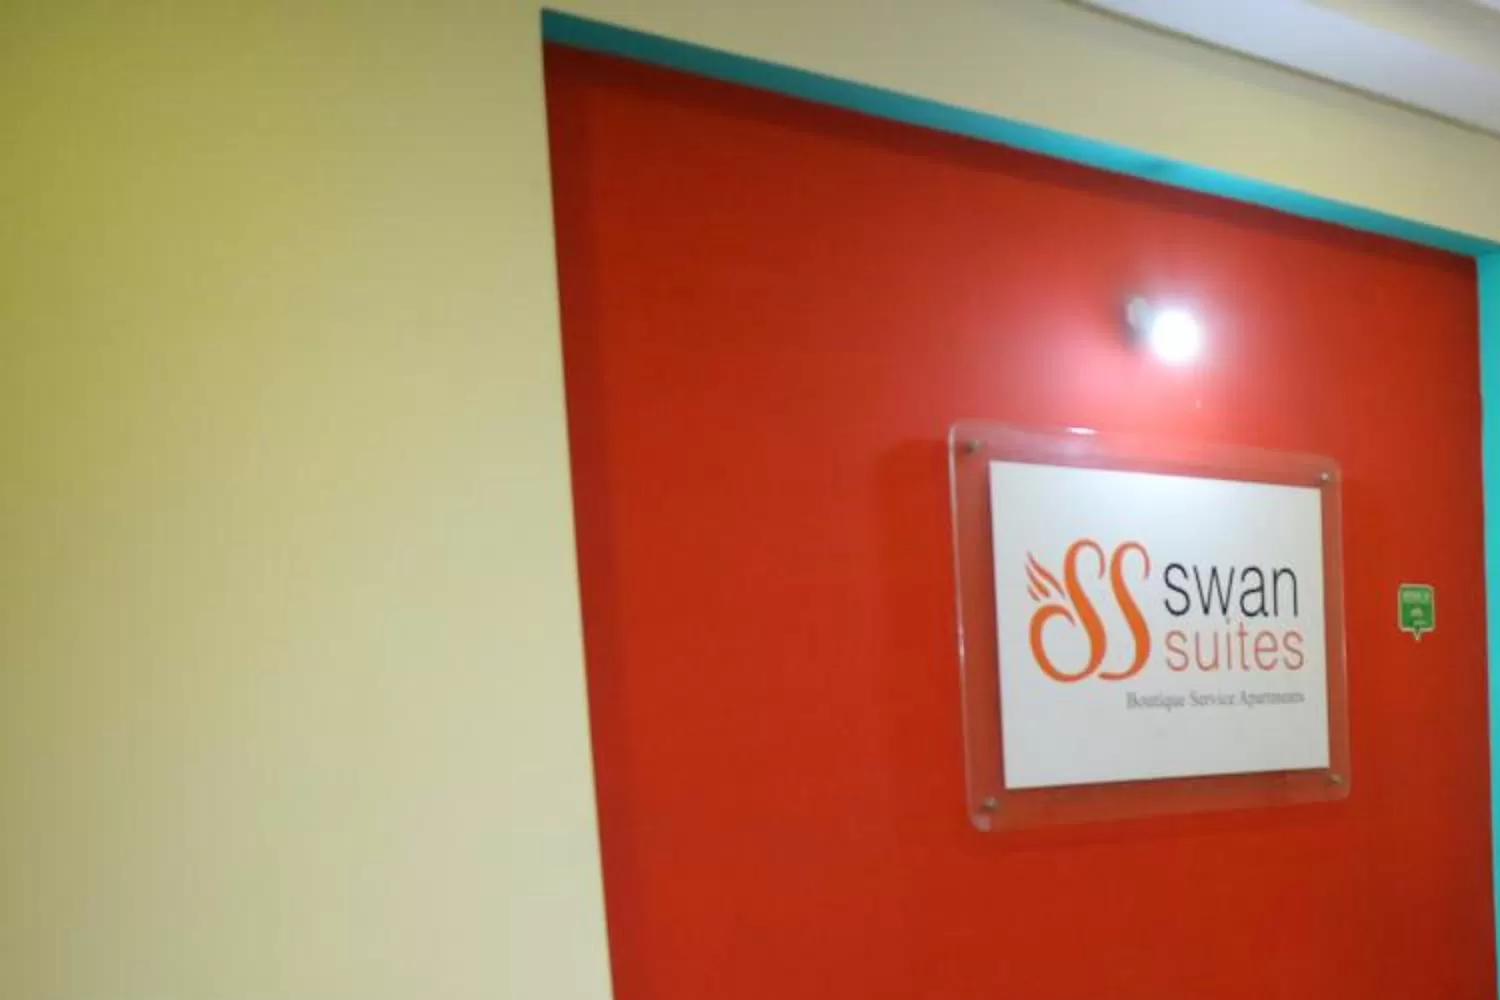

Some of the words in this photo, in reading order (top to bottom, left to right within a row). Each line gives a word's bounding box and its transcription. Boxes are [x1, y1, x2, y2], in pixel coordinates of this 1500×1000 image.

[1163, 562, 1299, 617] swan
[1164, 616, 1305, 672] suites
[1126, 690, 1185, 712] Boutique
